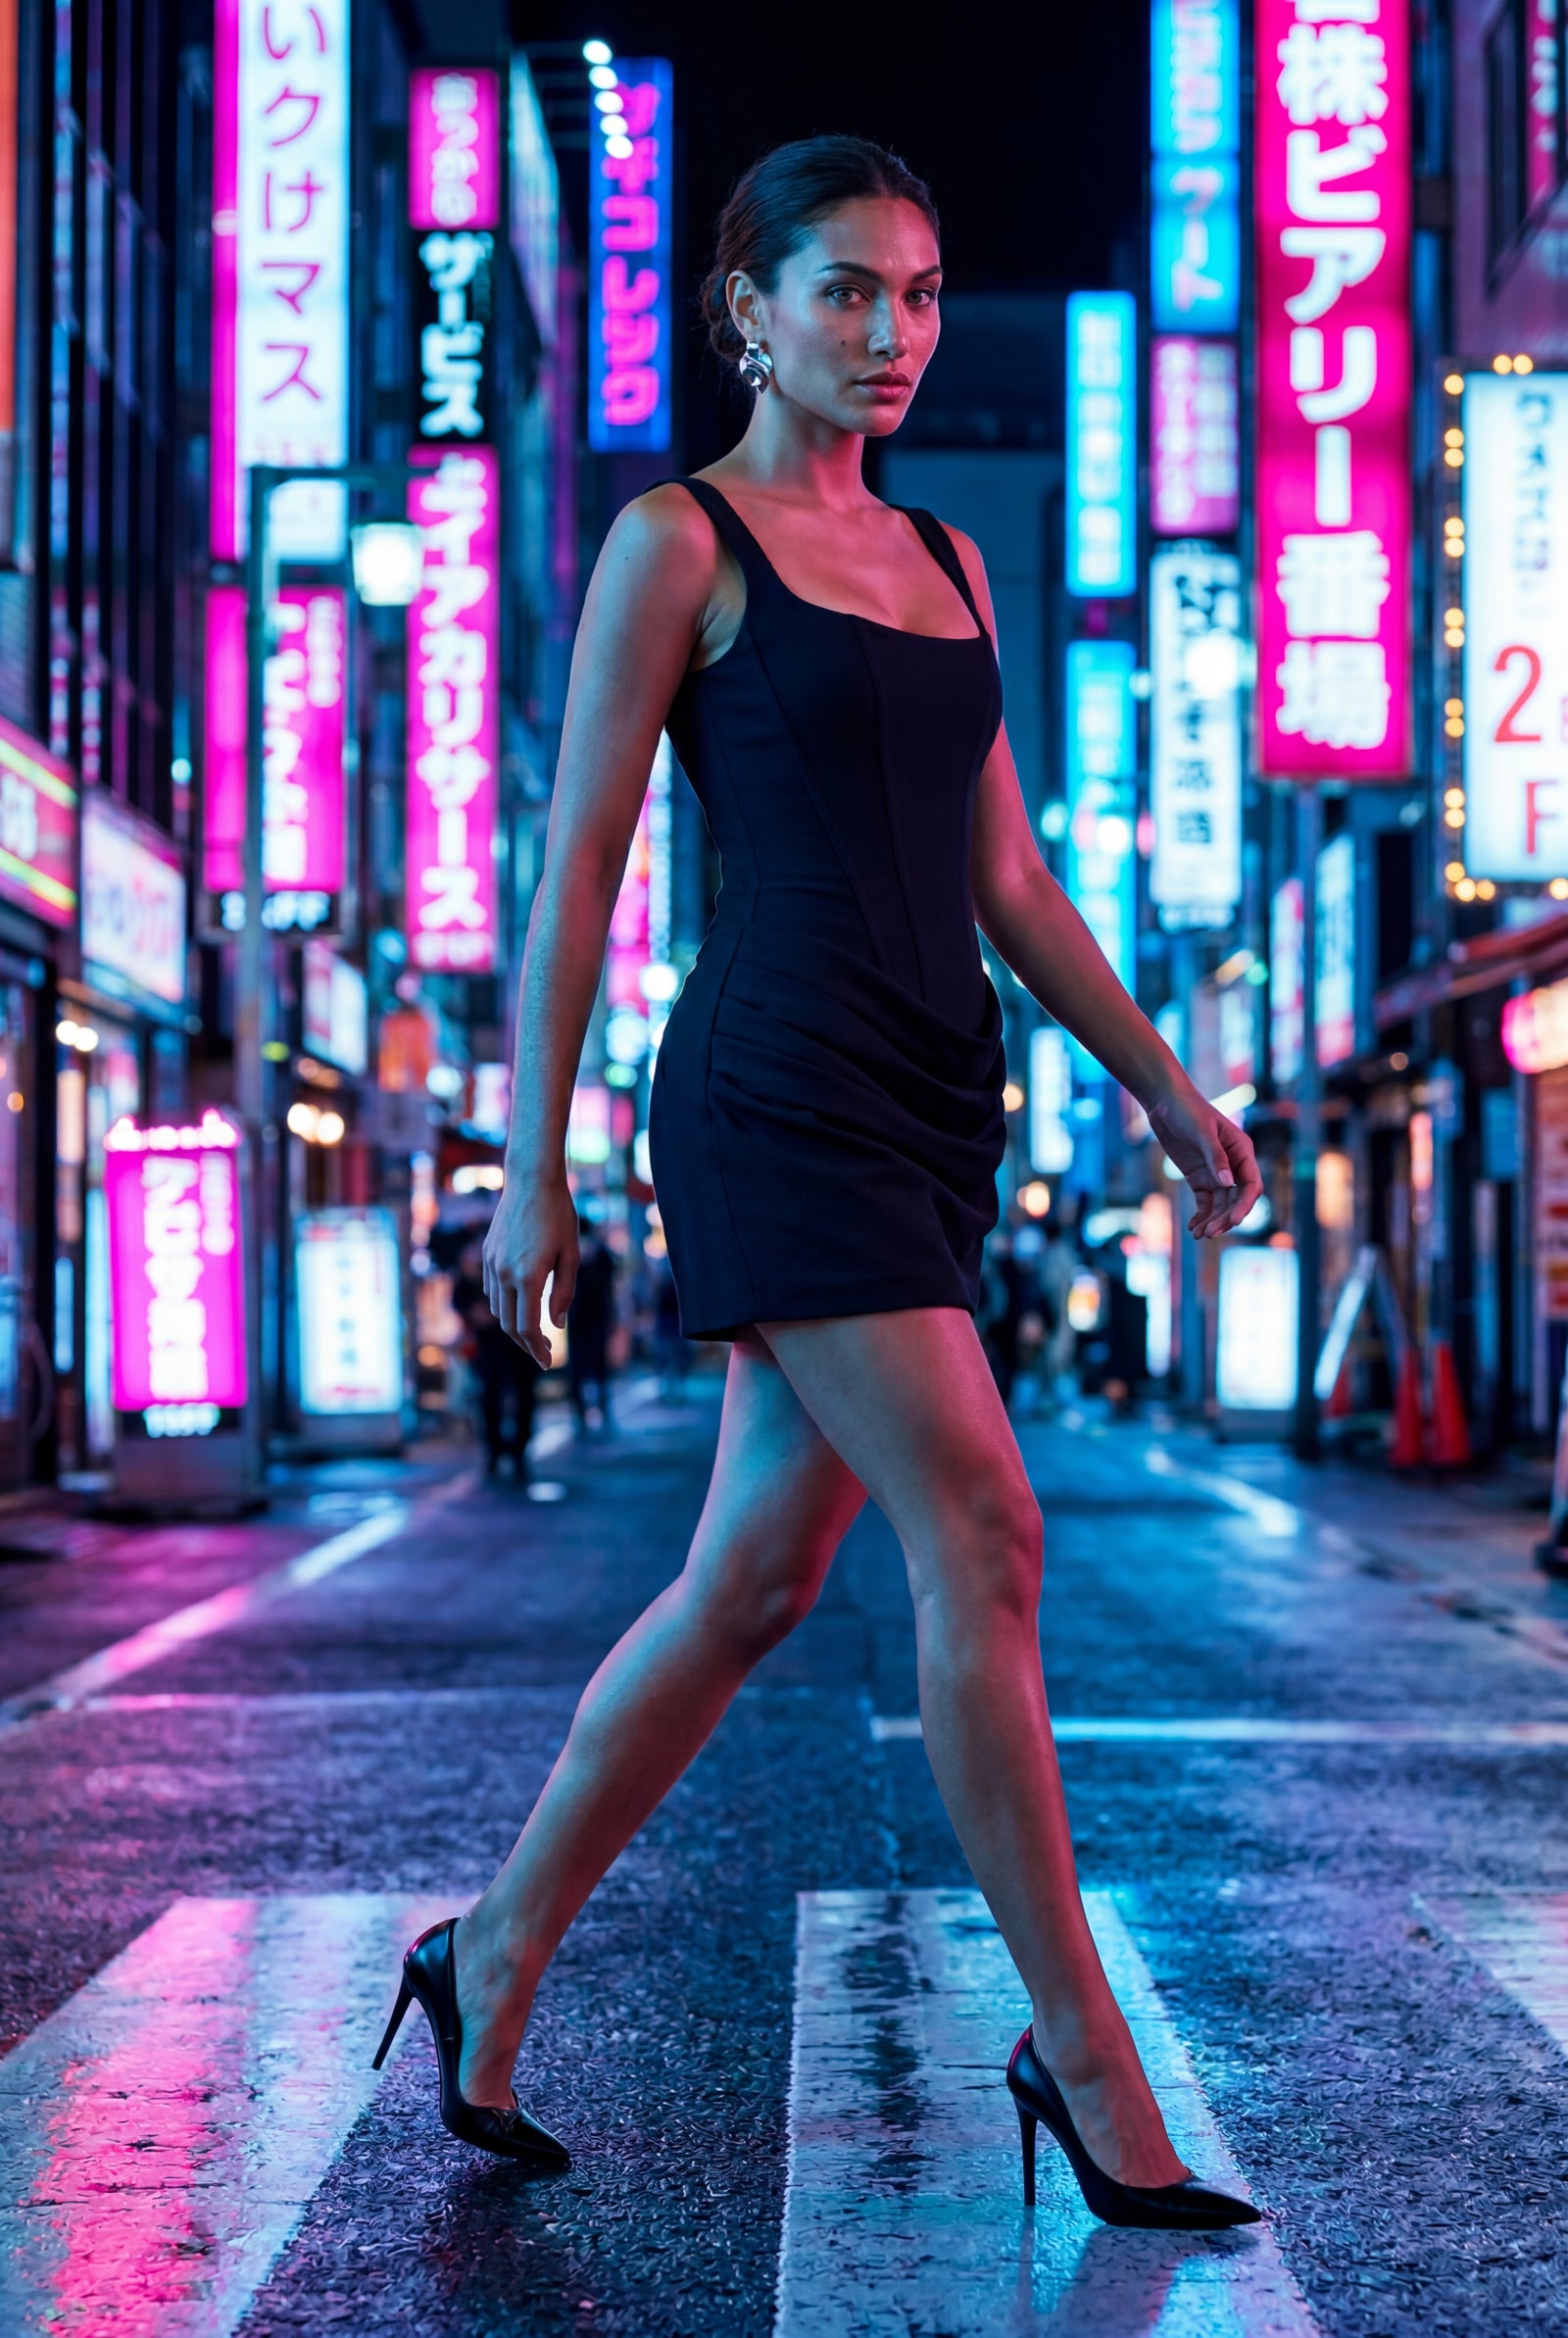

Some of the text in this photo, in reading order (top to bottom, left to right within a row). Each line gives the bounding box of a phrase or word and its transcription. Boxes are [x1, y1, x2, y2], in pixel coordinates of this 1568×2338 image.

[263, 6, 325, 400] いクけマス
[1276, 0, 1389, 749] 株ビアリー番場
[1494, 644, 1543, 743] 2
[1525, 779, 1559, 855] F
